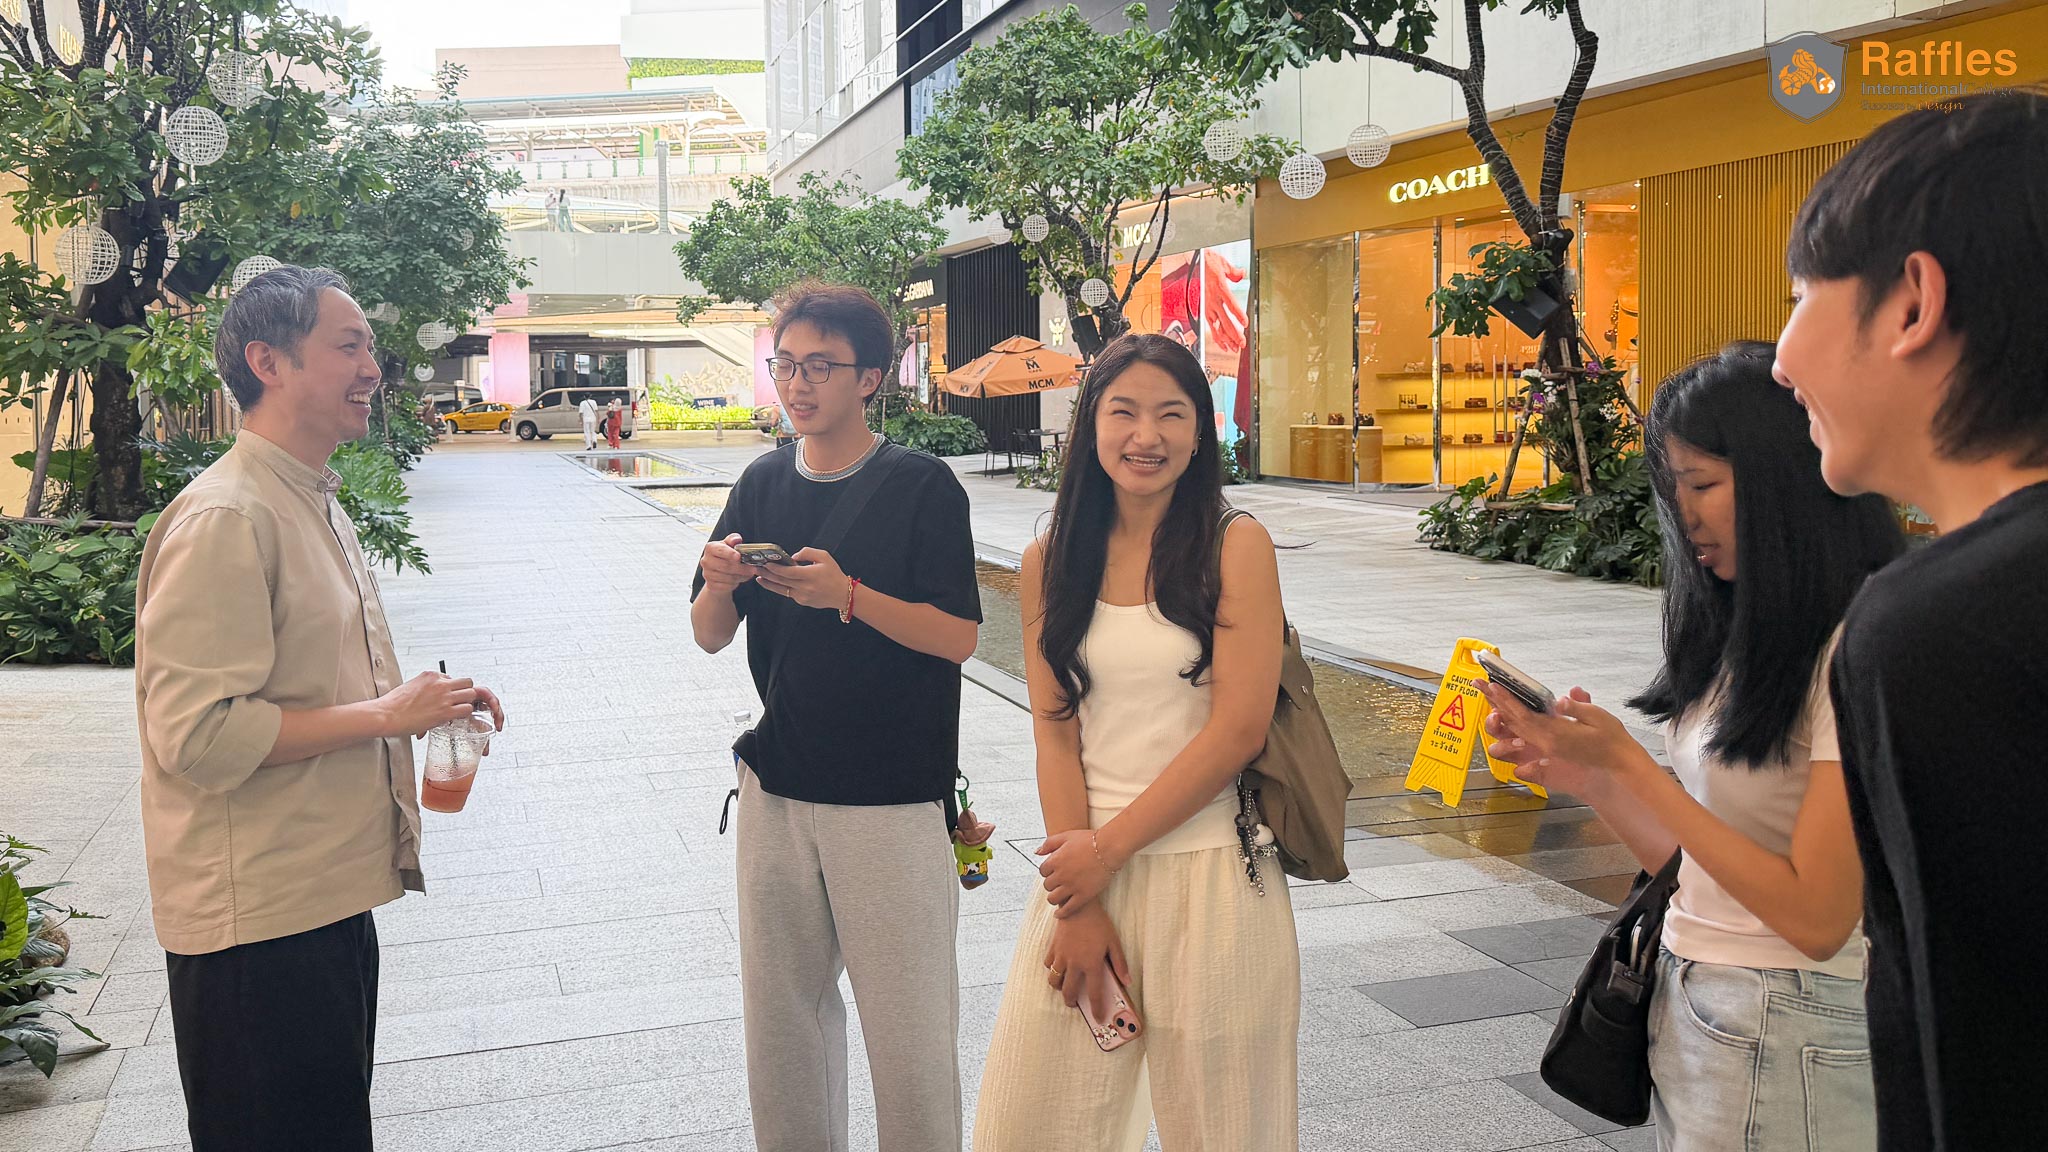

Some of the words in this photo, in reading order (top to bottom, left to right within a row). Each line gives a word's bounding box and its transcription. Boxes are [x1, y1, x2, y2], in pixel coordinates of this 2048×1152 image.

[1389, 163, 1490, 203] COACH
[1028, 378, 1055, 390] MCM
[1451, 674, 1475, 688] CAUTIO
[1445, 682, 1458, 692] WET
[1459, 686, 1479, 698] FLOOR
